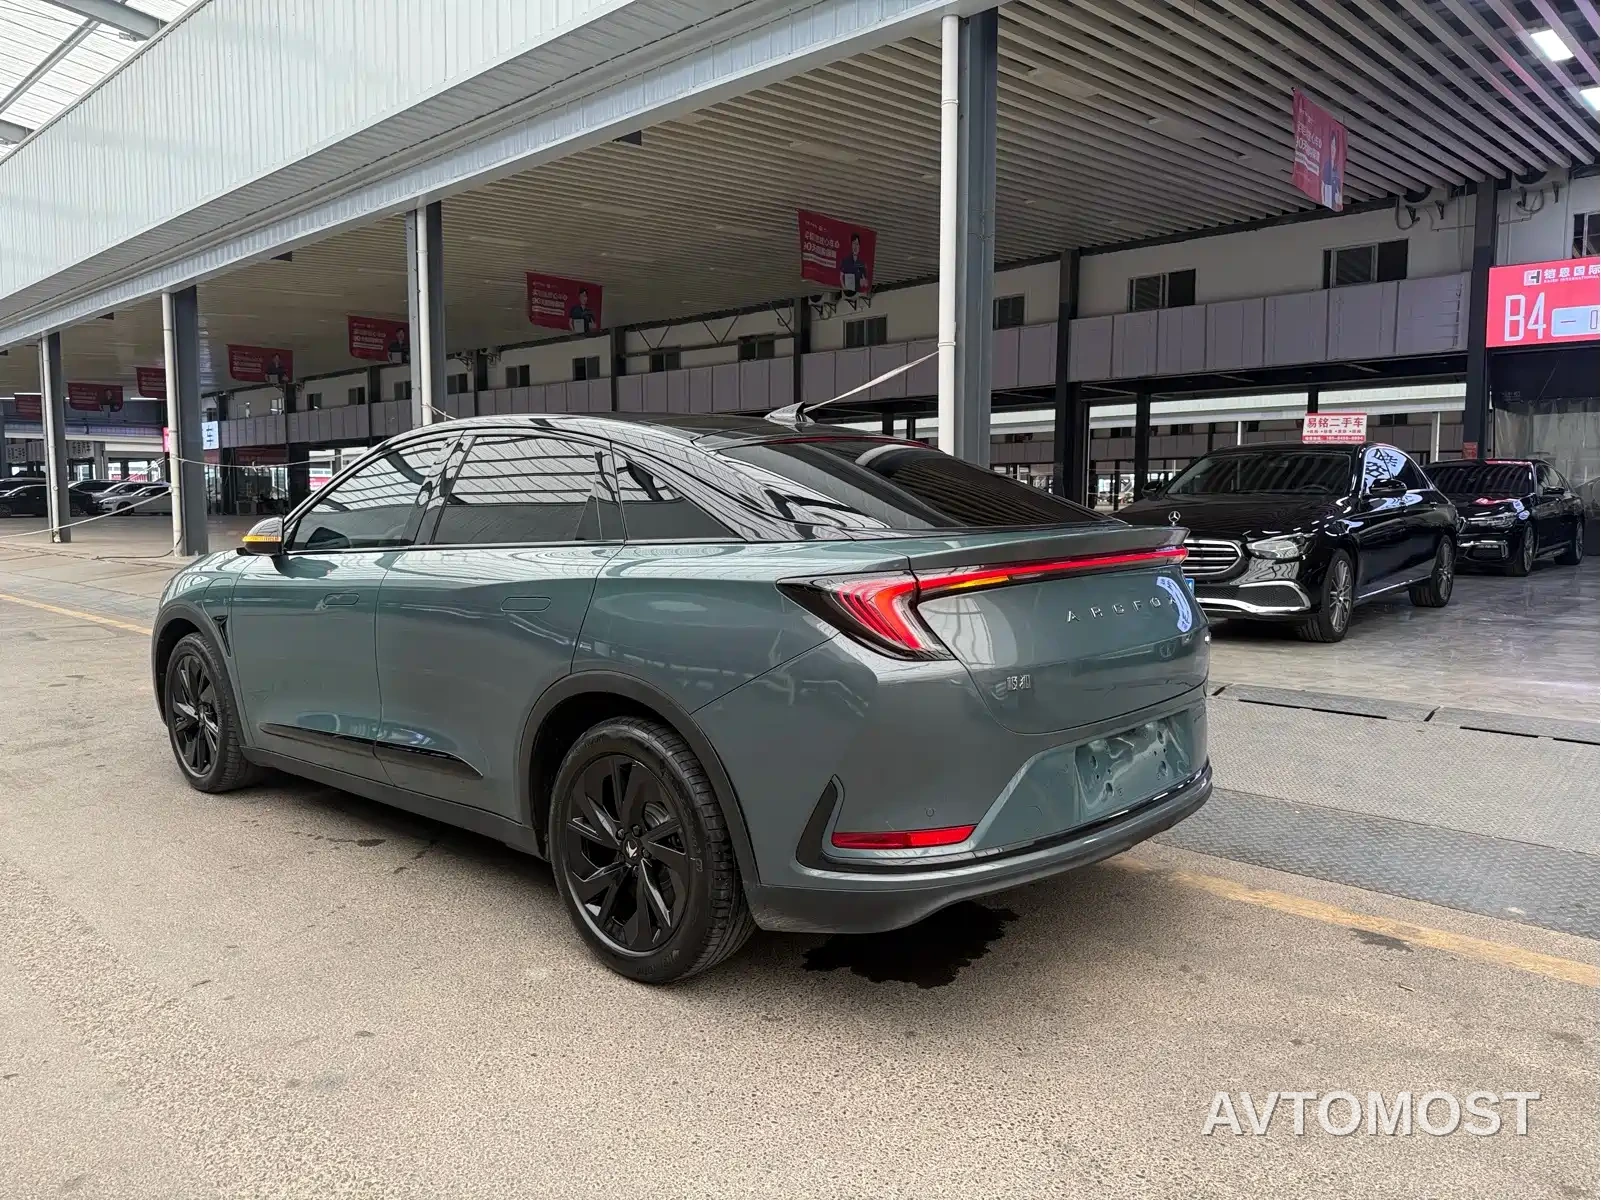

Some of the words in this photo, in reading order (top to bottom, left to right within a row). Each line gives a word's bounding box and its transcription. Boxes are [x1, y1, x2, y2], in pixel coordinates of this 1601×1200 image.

[1504, 292, 1546, 341] B4
[1307, 417, 1363, 428] 易铭二手车
